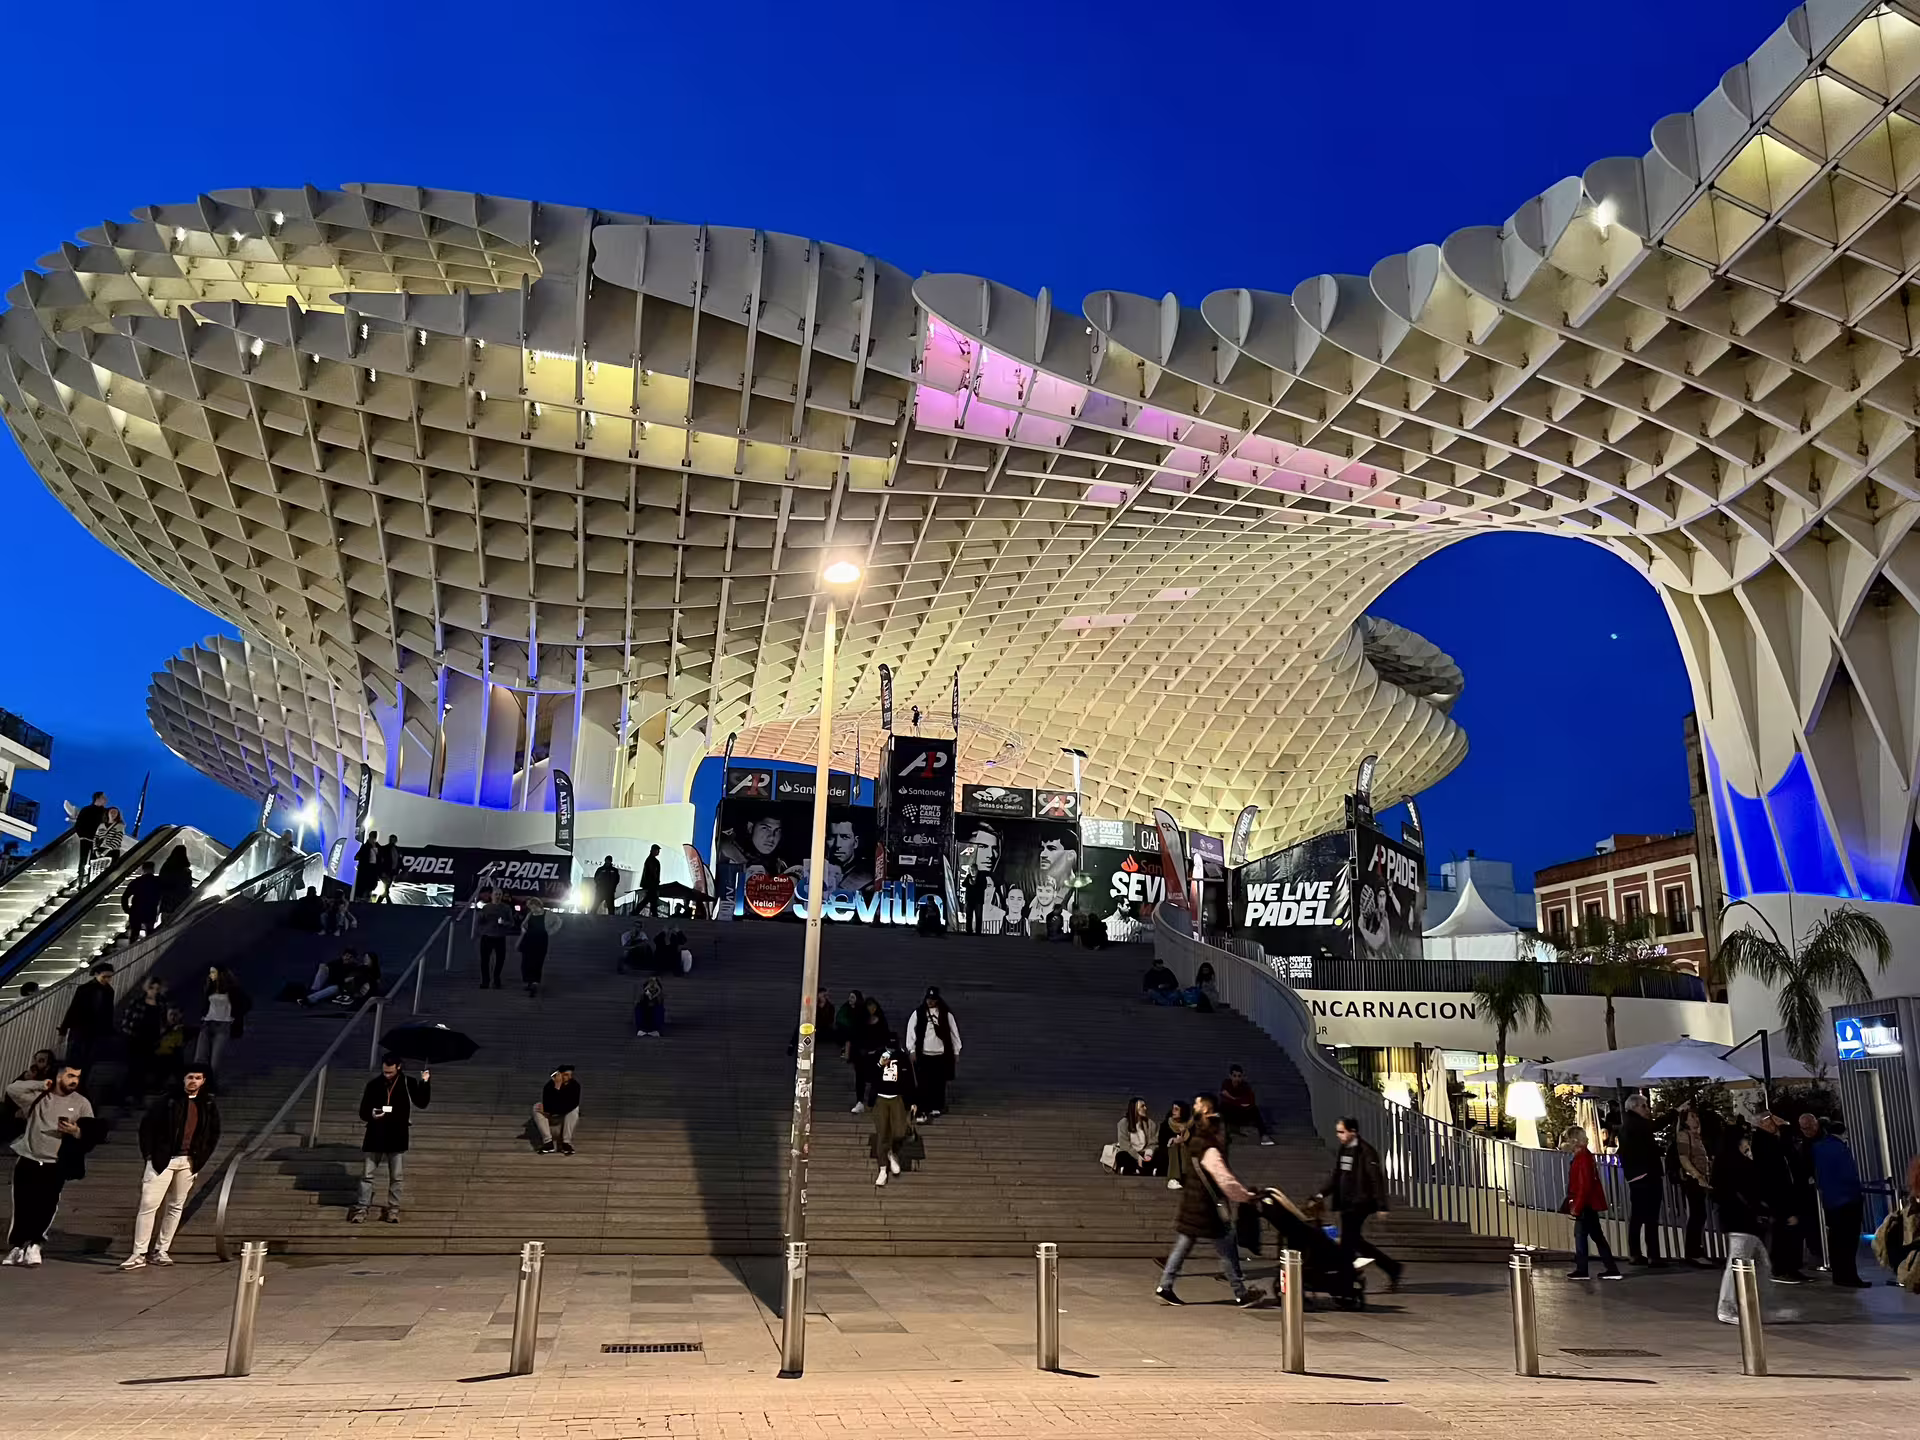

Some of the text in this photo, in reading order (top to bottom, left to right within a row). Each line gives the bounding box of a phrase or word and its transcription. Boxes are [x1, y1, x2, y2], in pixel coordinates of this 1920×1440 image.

[793, 784, 846, 797] Santder
[909, 788, 945, 796] Santander
[1100, 820, 1124, 828] MONTE
[399, 856, 454, 874] PADEL
[505, 861, 560, 880] PADEL
[1386, 848, 1420, 893] PADEL
[478, 876, 540, 892] ENTRADA
[1246, 881, 1334, 902] WE LIVE
